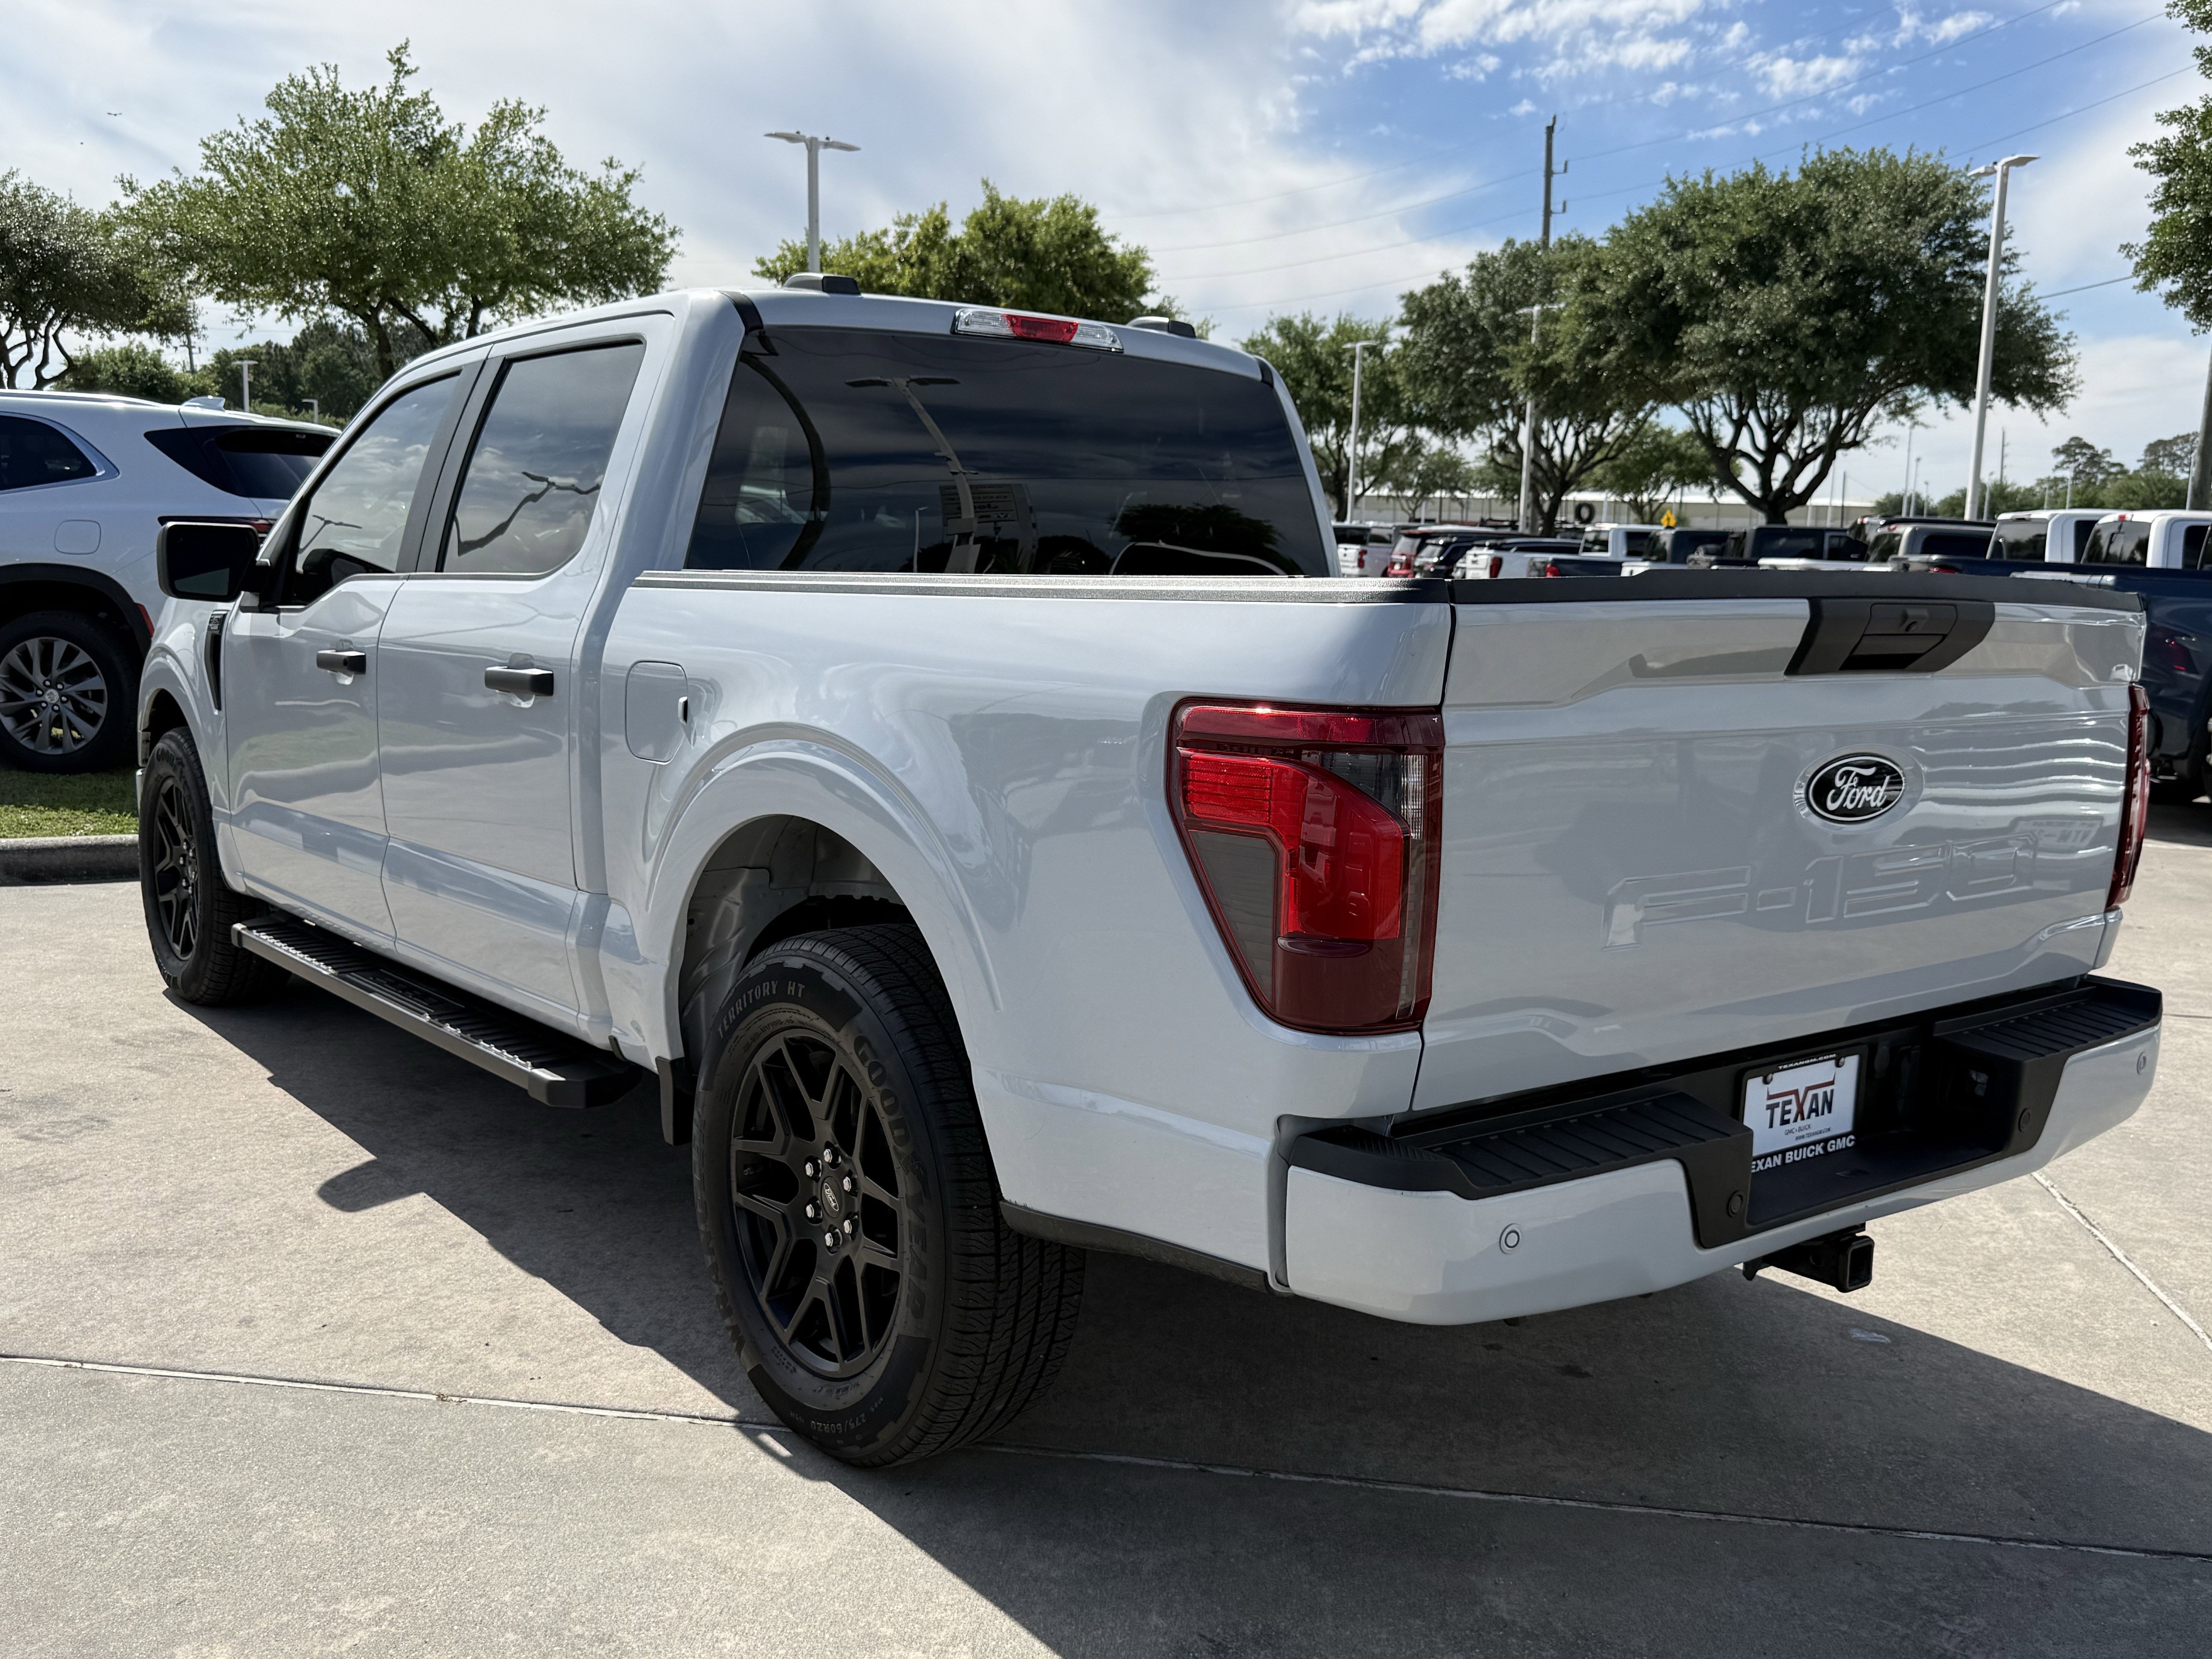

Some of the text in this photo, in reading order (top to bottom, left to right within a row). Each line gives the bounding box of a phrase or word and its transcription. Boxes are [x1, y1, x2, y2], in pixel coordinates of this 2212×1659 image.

[1826, 766, 1890, 811] Ford
[1601, 833, 2038, 951] F-150
[718, 980, 778, 1039] TERRITORY
[787, 981, 805, 998] HT
[1778, 1053, 1836, 1070] TEXANGM.COM
[1765, 1084, 1835, 1129] TEXAN
[1798, 1124, 1811, 1132] BUICK
[854, 1035, 928, 1318] GOODYEAR
[1751, 1135, 1856, 1173] EXAN BUICK GMC
[811, 1412, 867, 1433] 275/60R20
